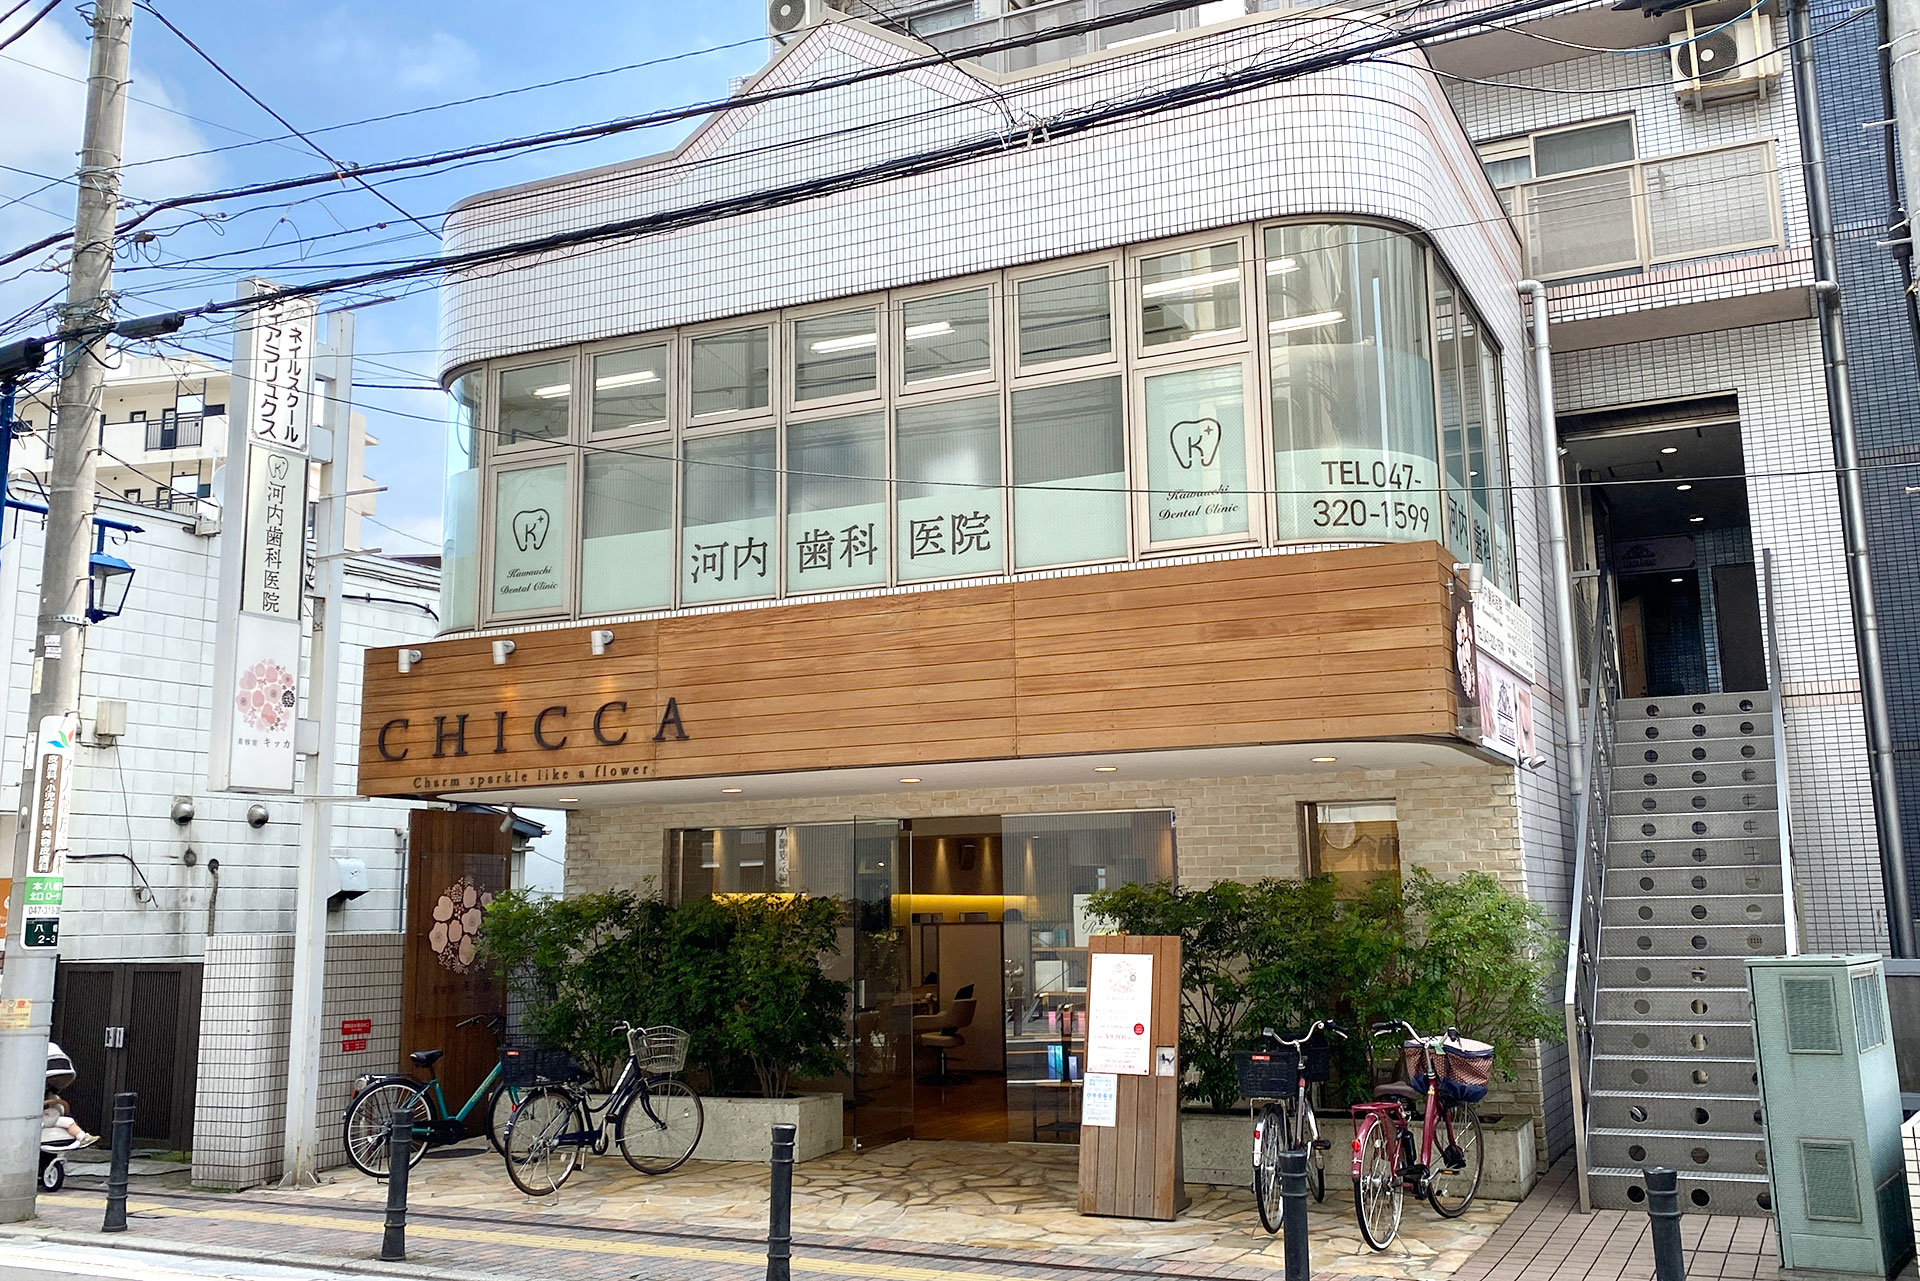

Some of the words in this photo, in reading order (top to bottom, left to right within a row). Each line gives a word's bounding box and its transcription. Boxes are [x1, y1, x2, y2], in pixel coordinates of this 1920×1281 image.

[284, 327, 303, 442] ネイルスクール
[1158, 505, 1202, 520] Dental
[1205, 503, 1239, 515] Clinic
[1313, 499, 1429, 533] 320-1599
[262, 481, 286, 613] 河内歯科医院
[506, 565, 553, 579] Kawauchi
[499, 583, 532, 595] Dental
[533, 581, 558, 592] Clinic
[377, 697, 689, 761] CHICCA
[263, 738, 291, 749] キッカ
[413, 777, 460, 789] Charm
[469, 771, 528, 787] sparkle
[537, 768, 569, 781] like
[578, 770, 585, 779] a
[594, 765, 649, 778] flower
